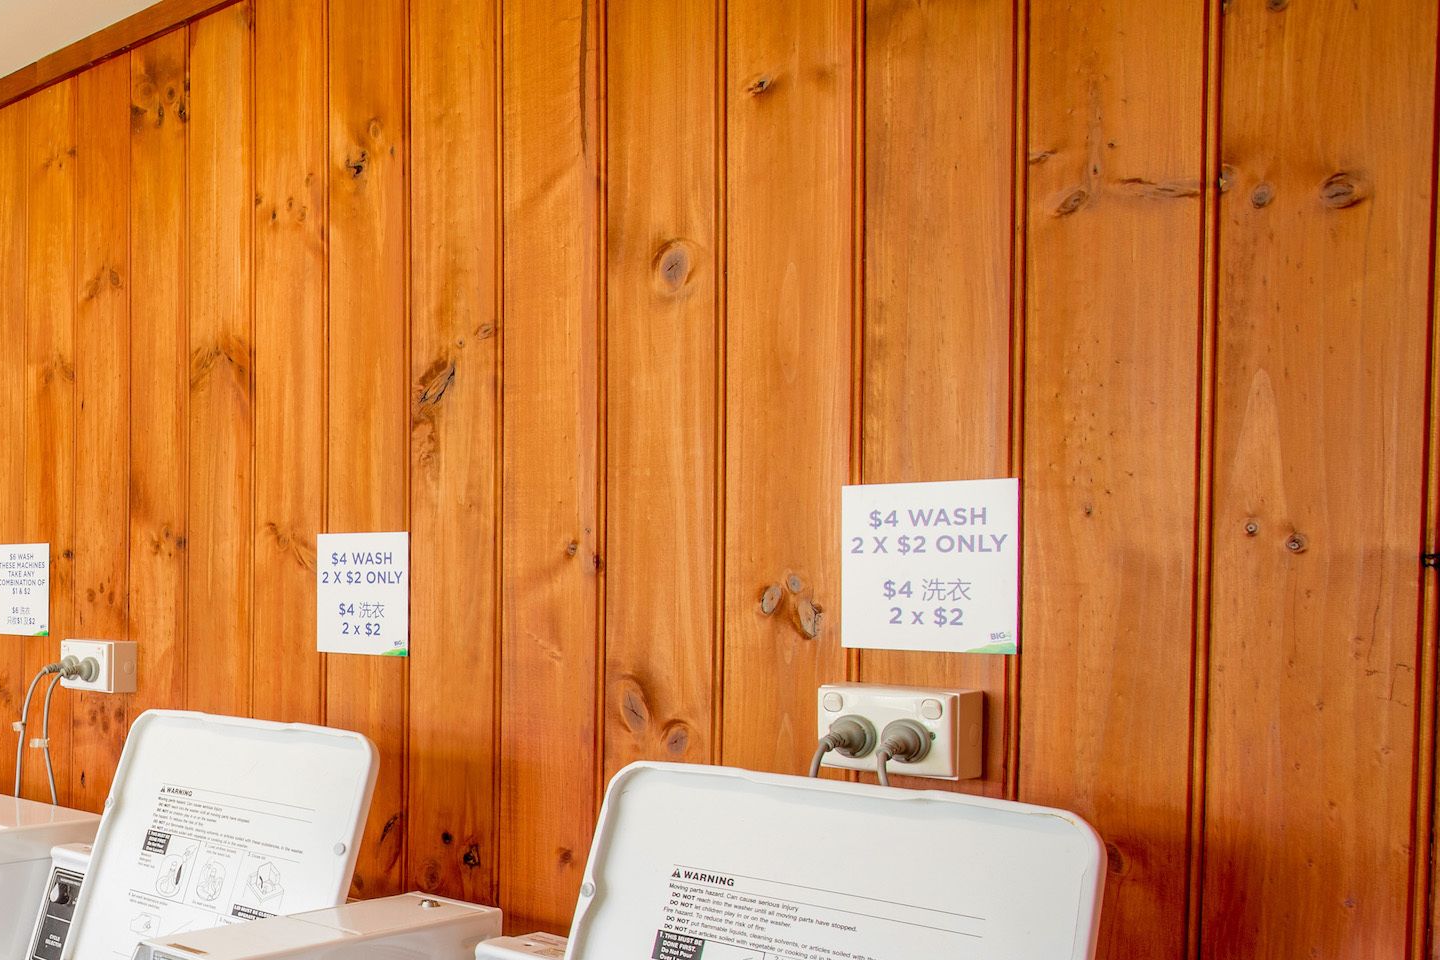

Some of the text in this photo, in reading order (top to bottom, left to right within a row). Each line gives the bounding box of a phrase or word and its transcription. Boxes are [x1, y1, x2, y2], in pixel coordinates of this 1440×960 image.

[869, 507, 986, 530] $4 WASH
[851, 534, 1008, 555] 2 X $2 ONLY
[331, 552, 392, 566] $4 WASH
[322, 571, 403, 585] 2 X $2 ONLY
[883, 578, 972, 601] $4 洗衣
[339, 602, 385, 618] $4 洗衣
[889, 606, 963, 627] 2 x $2
[342, 623, 349, 634] 2
[365, 623, 380, 636] $2
[167, 787, 192, 796] WARNING
[684, 870, 734, 886] WARNING
[668, 882, 688, 892] Moving
[704, 889, 724, 898] hazard.
[758, 900, 780, 908] serious
[781, 903, 799, 913] injury
[674, 908, 693, 917] hazard.
[703, 915, 723, 923] reduce
[701, 906, 723, 914] children
[770, 920, 791, 928] washer.
[775, 912, 797, 922] moving
[831, 922, 856, 932] stopped.
[700, 922, 728, 932] flammable
[729, 928, 748, 937] liquids,
[749, 933, 773, 943] cleaning
[774, 938, 799, 948] solvents,
[808, 945, 830, 954] articles
[832, 950, 851, 958] soiled
[748, 942, 776, 951] vegetable
[784, 949, 808, 959] cooking
